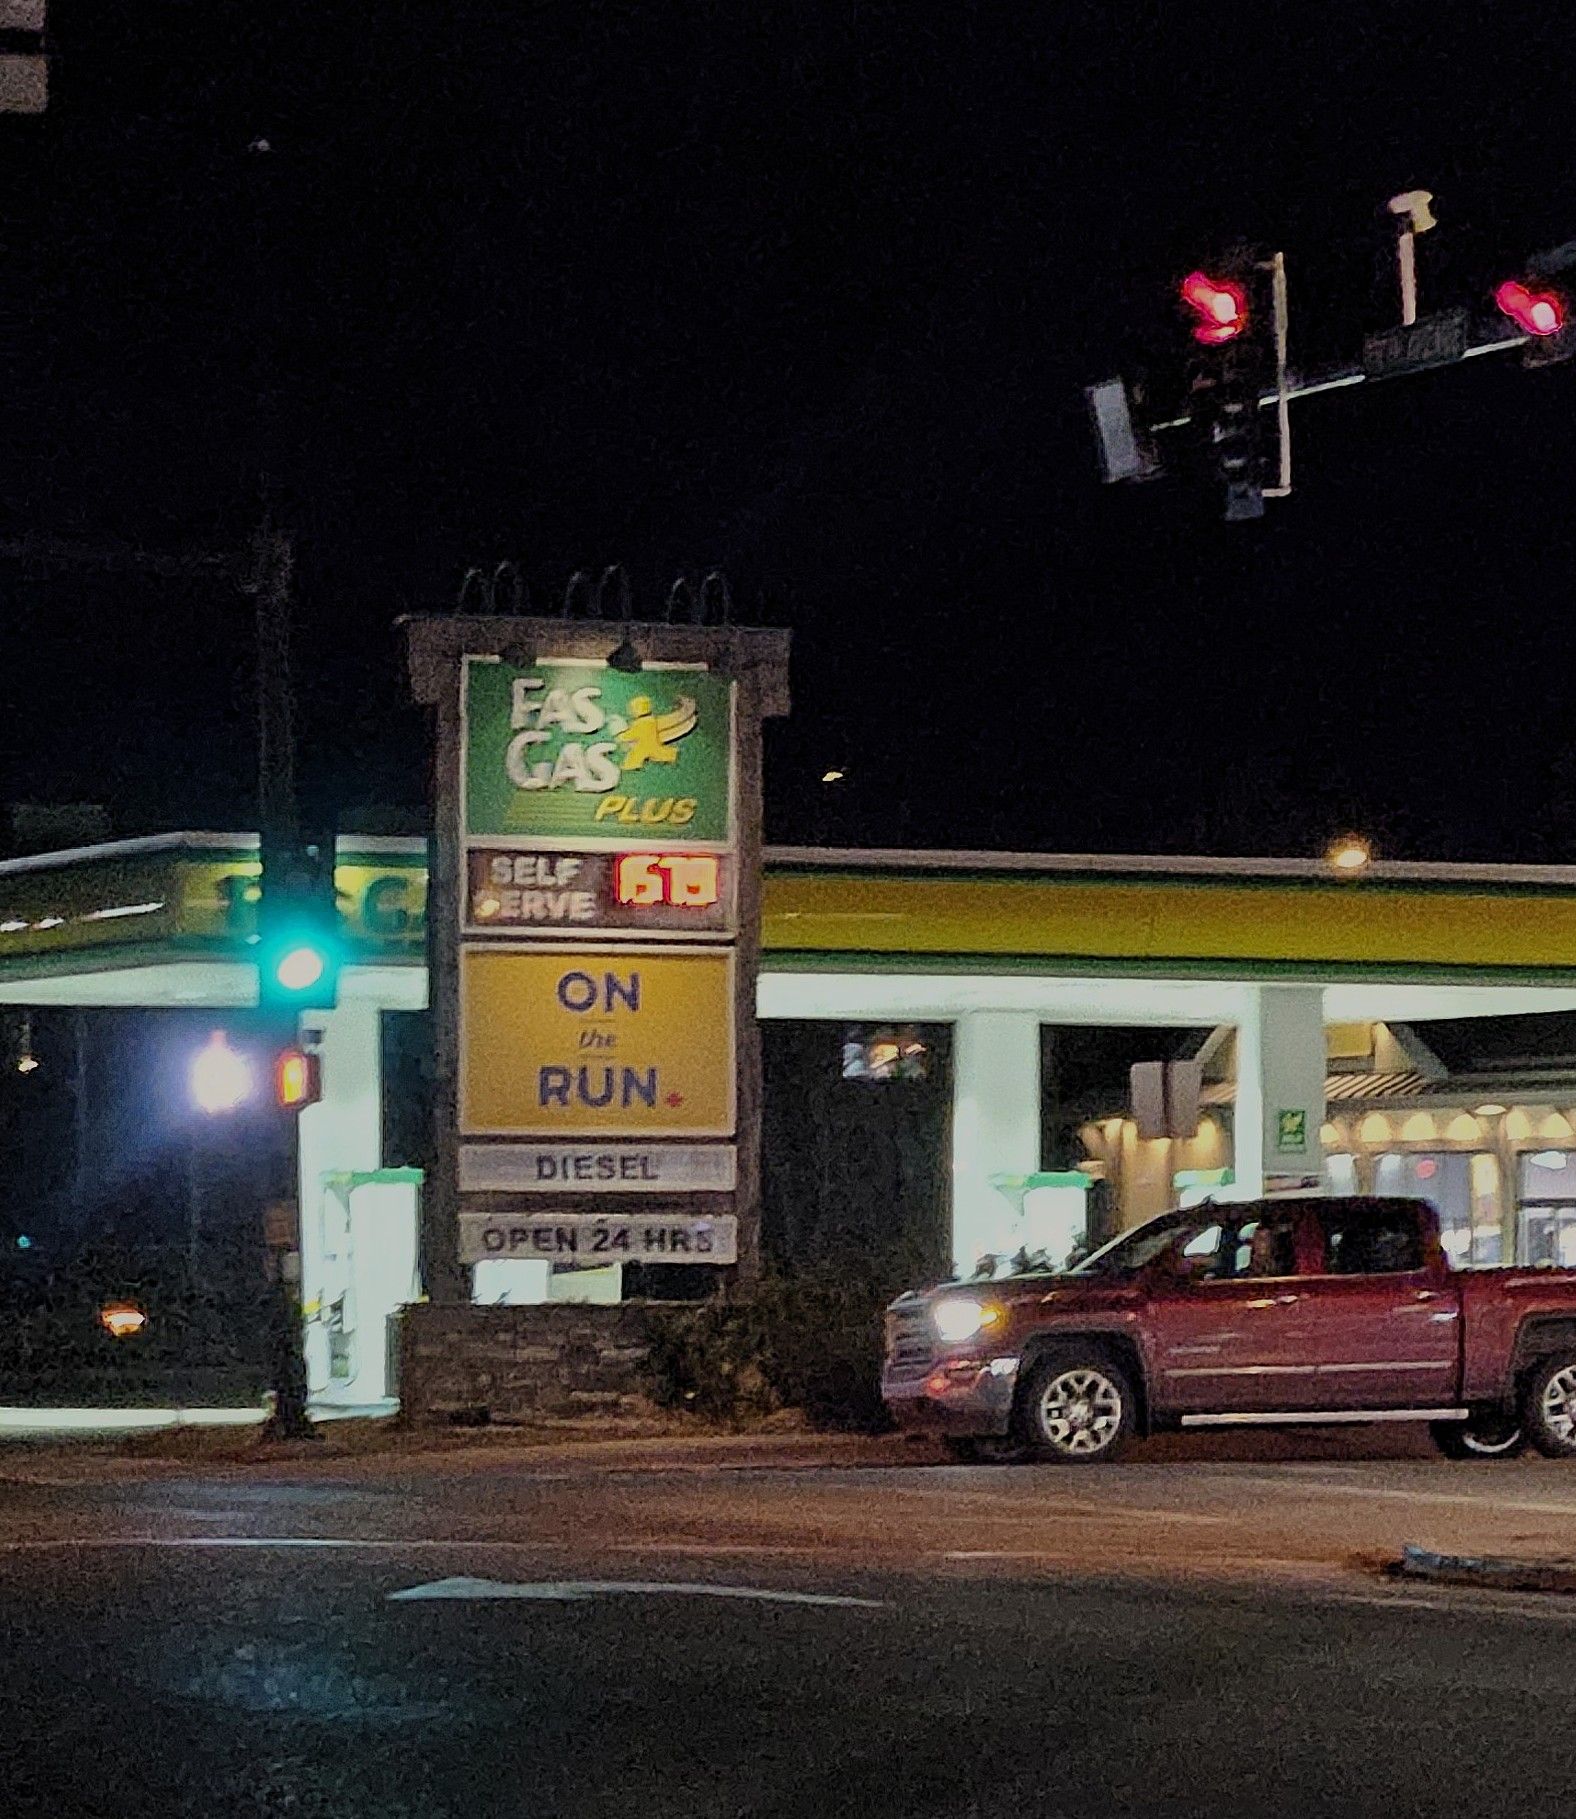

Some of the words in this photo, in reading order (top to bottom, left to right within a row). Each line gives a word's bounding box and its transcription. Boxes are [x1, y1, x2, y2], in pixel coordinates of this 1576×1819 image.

[510, 677, 606, 734] FAS
[506, 730, 621, 793] GAS
[595, 796, 698, 824] PLUS
[491, 856, 583, 888] SELF
[475, 889, 598, 922] ERVE
[556, 971, 641, 1013] ON
[579, 1029, 617, 1049] the
[538, 1065, 658, 1109] RUN
[535, 1154, 660, 1181] DIESEL
[482, 1227, 578, 1253] OPEN
[590, 1228, 631, 1252] 24
[643, 1228, 714, 1253] HRS
